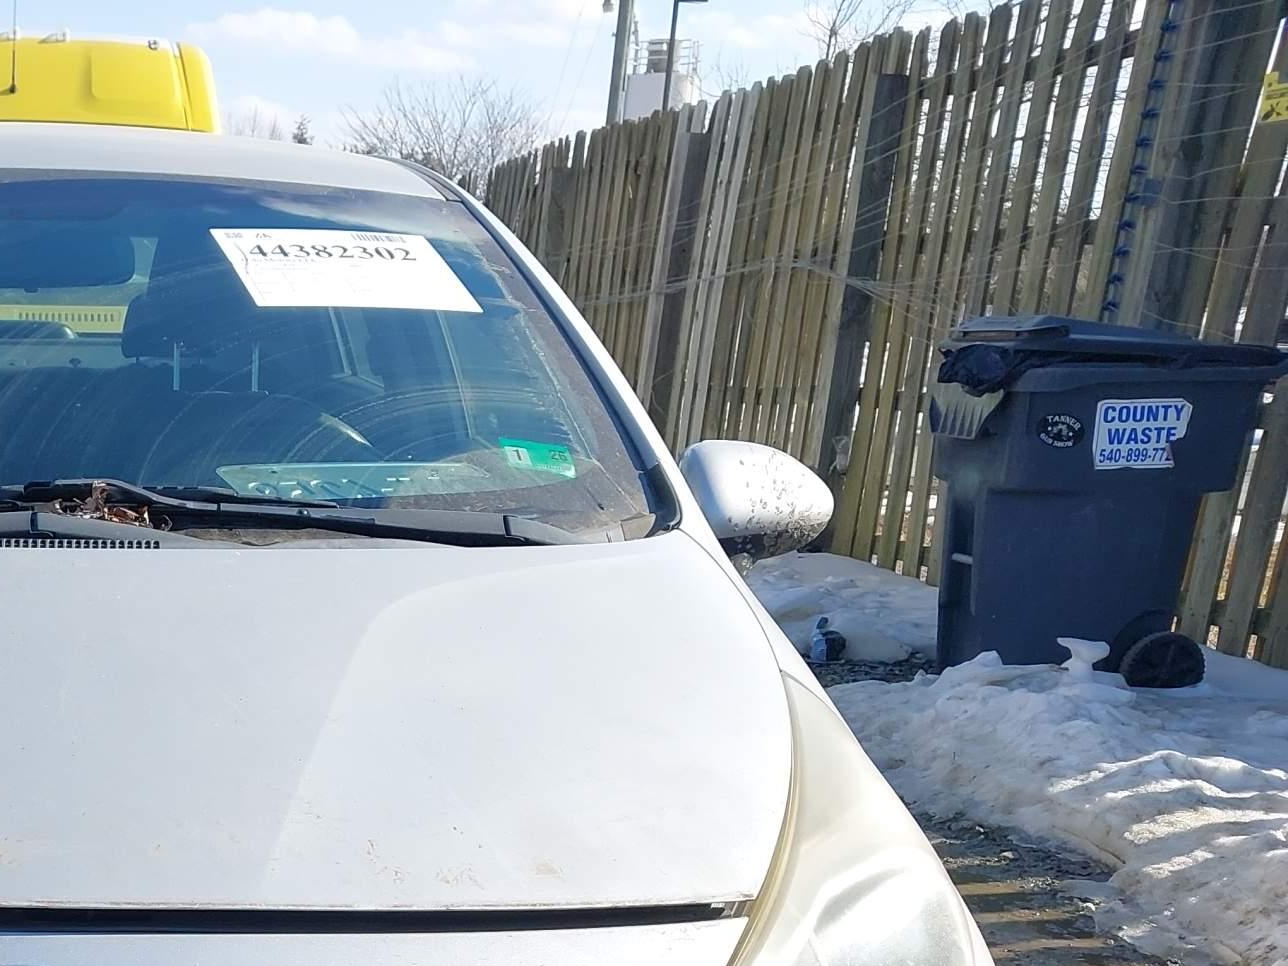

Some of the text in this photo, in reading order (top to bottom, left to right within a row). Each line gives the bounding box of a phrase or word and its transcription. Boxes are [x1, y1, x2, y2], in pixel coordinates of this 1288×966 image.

[249, 244, 418, 262] 44382302
[1103, 404, 1185, 424] COUNTY
[1107, 426, 1177, 446] WASTE
